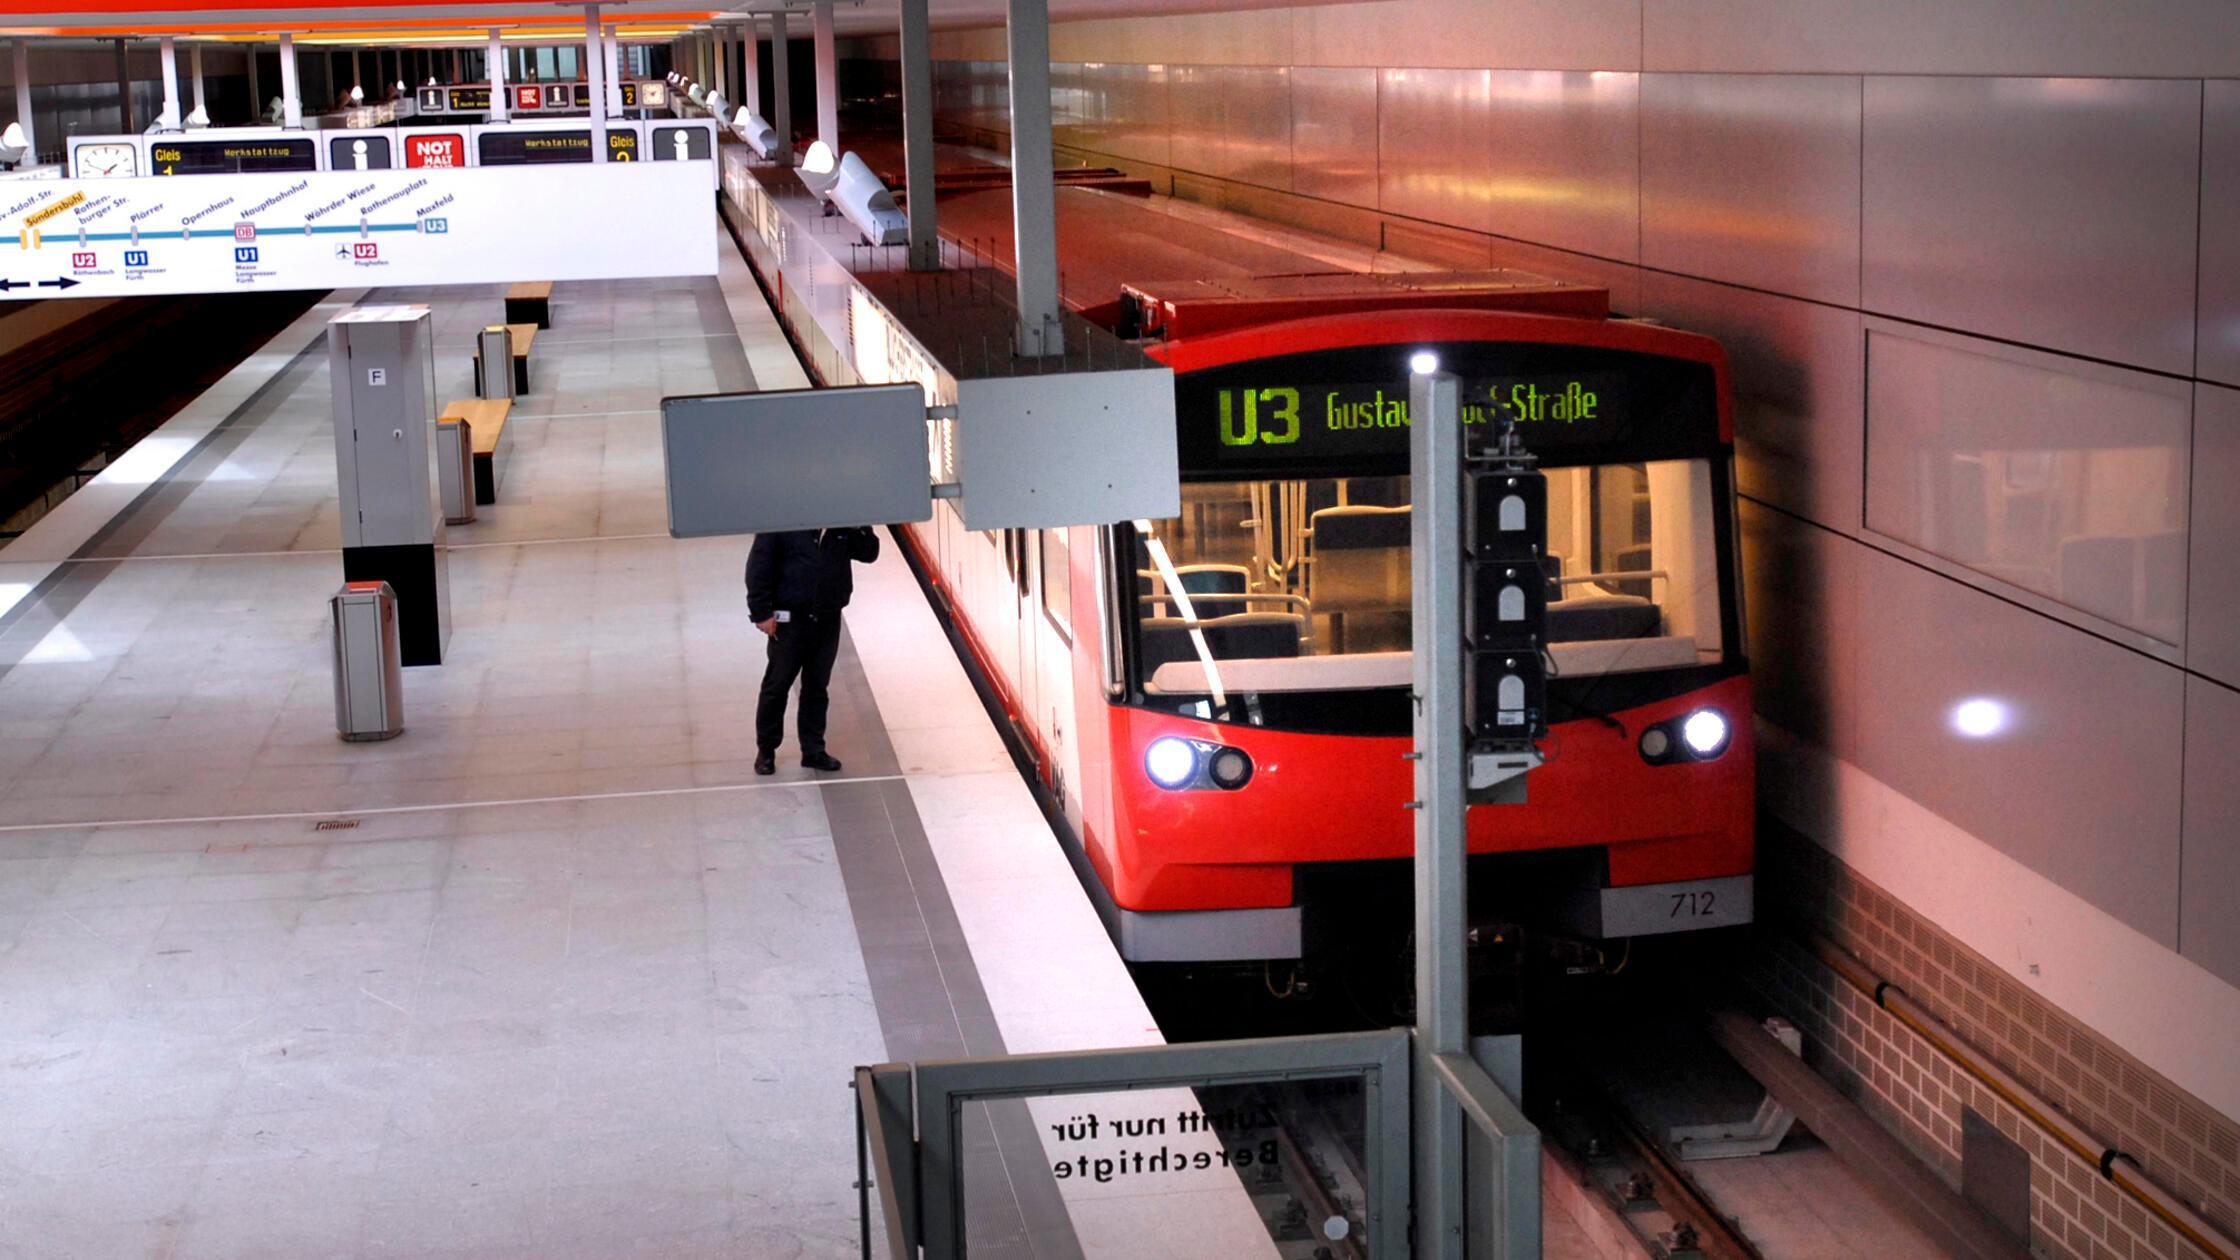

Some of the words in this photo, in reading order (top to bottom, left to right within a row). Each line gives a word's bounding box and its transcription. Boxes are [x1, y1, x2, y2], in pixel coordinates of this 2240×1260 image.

[416, 141, 452, 155] NOT
[610, 135, 634, 148] Gleis
[155, 148, 181, 162] Gleis
[424, 155, 453, 165] HALT
[346, 183, 376, 201] Wiese
[360, 178, 428, 216] Rathenauplatz
[240, 180, 309, 219] Hauptbahnhof
[416, 193, 455, 218] Maxfeld
[181, 196, 234, 227] Opernhaus
[426, 220, 445, 232] U3
[237, 249, 256, 261] U1
[356, 245, 376, 257] U2
[75, 255, 95, 267] U2
[127, 253, 146, 265] U1
[372, 371, 381, 383] F
[1219, 387, 1300, 446] U3
[1671, 892, 1715, 918] 712
